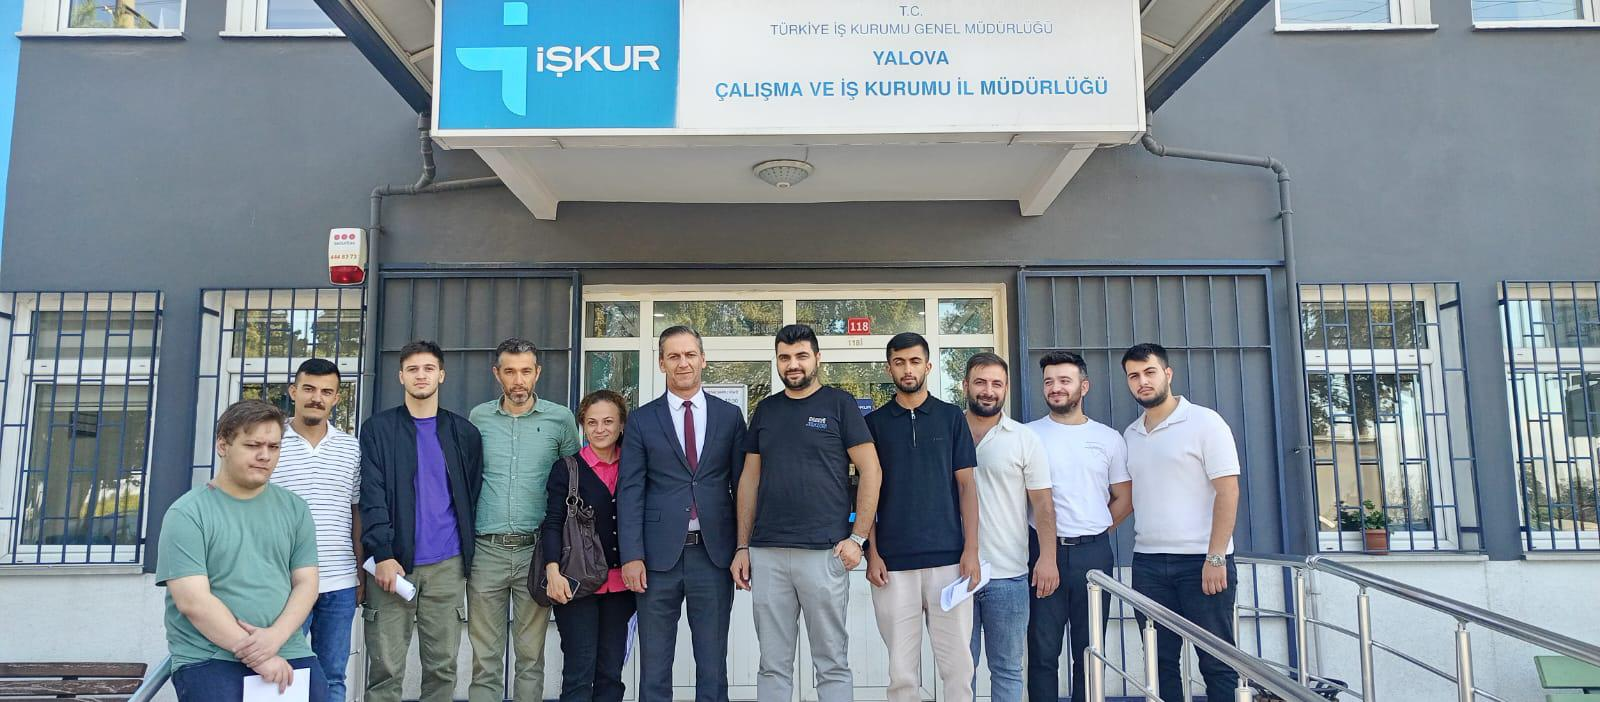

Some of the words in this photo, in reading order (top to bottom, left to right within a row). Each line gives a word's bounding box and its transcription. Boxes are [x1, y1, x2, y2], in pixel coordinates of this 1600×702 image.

[898, 5, 923, 17] T.C.
[770, 21, 829, 36] TÜRKİYE
[834, 21, 847, 37] İŞ
[850, 23, 910, 35] KURUMU
[914, 23, 960, 35] GENEL
[964, 20, 1053, 35] MÜDÜRLÜĞÜ
[536, 45, 660, 78] İŞKUR
[872, 50, 950, 66] YALOVA
[715, 81, 804, 102] ÇALIŞMA
[809, 81, 835, 97] VE
[841, 77, 859, 101] İŞ
[865, 80, 951, 97] KURUMU
[957, 76, 975, 96] İL
[980, 75, 1108, 96] MÜDÜRLÜĞÜ
[850, 321, 869, 332] 118
